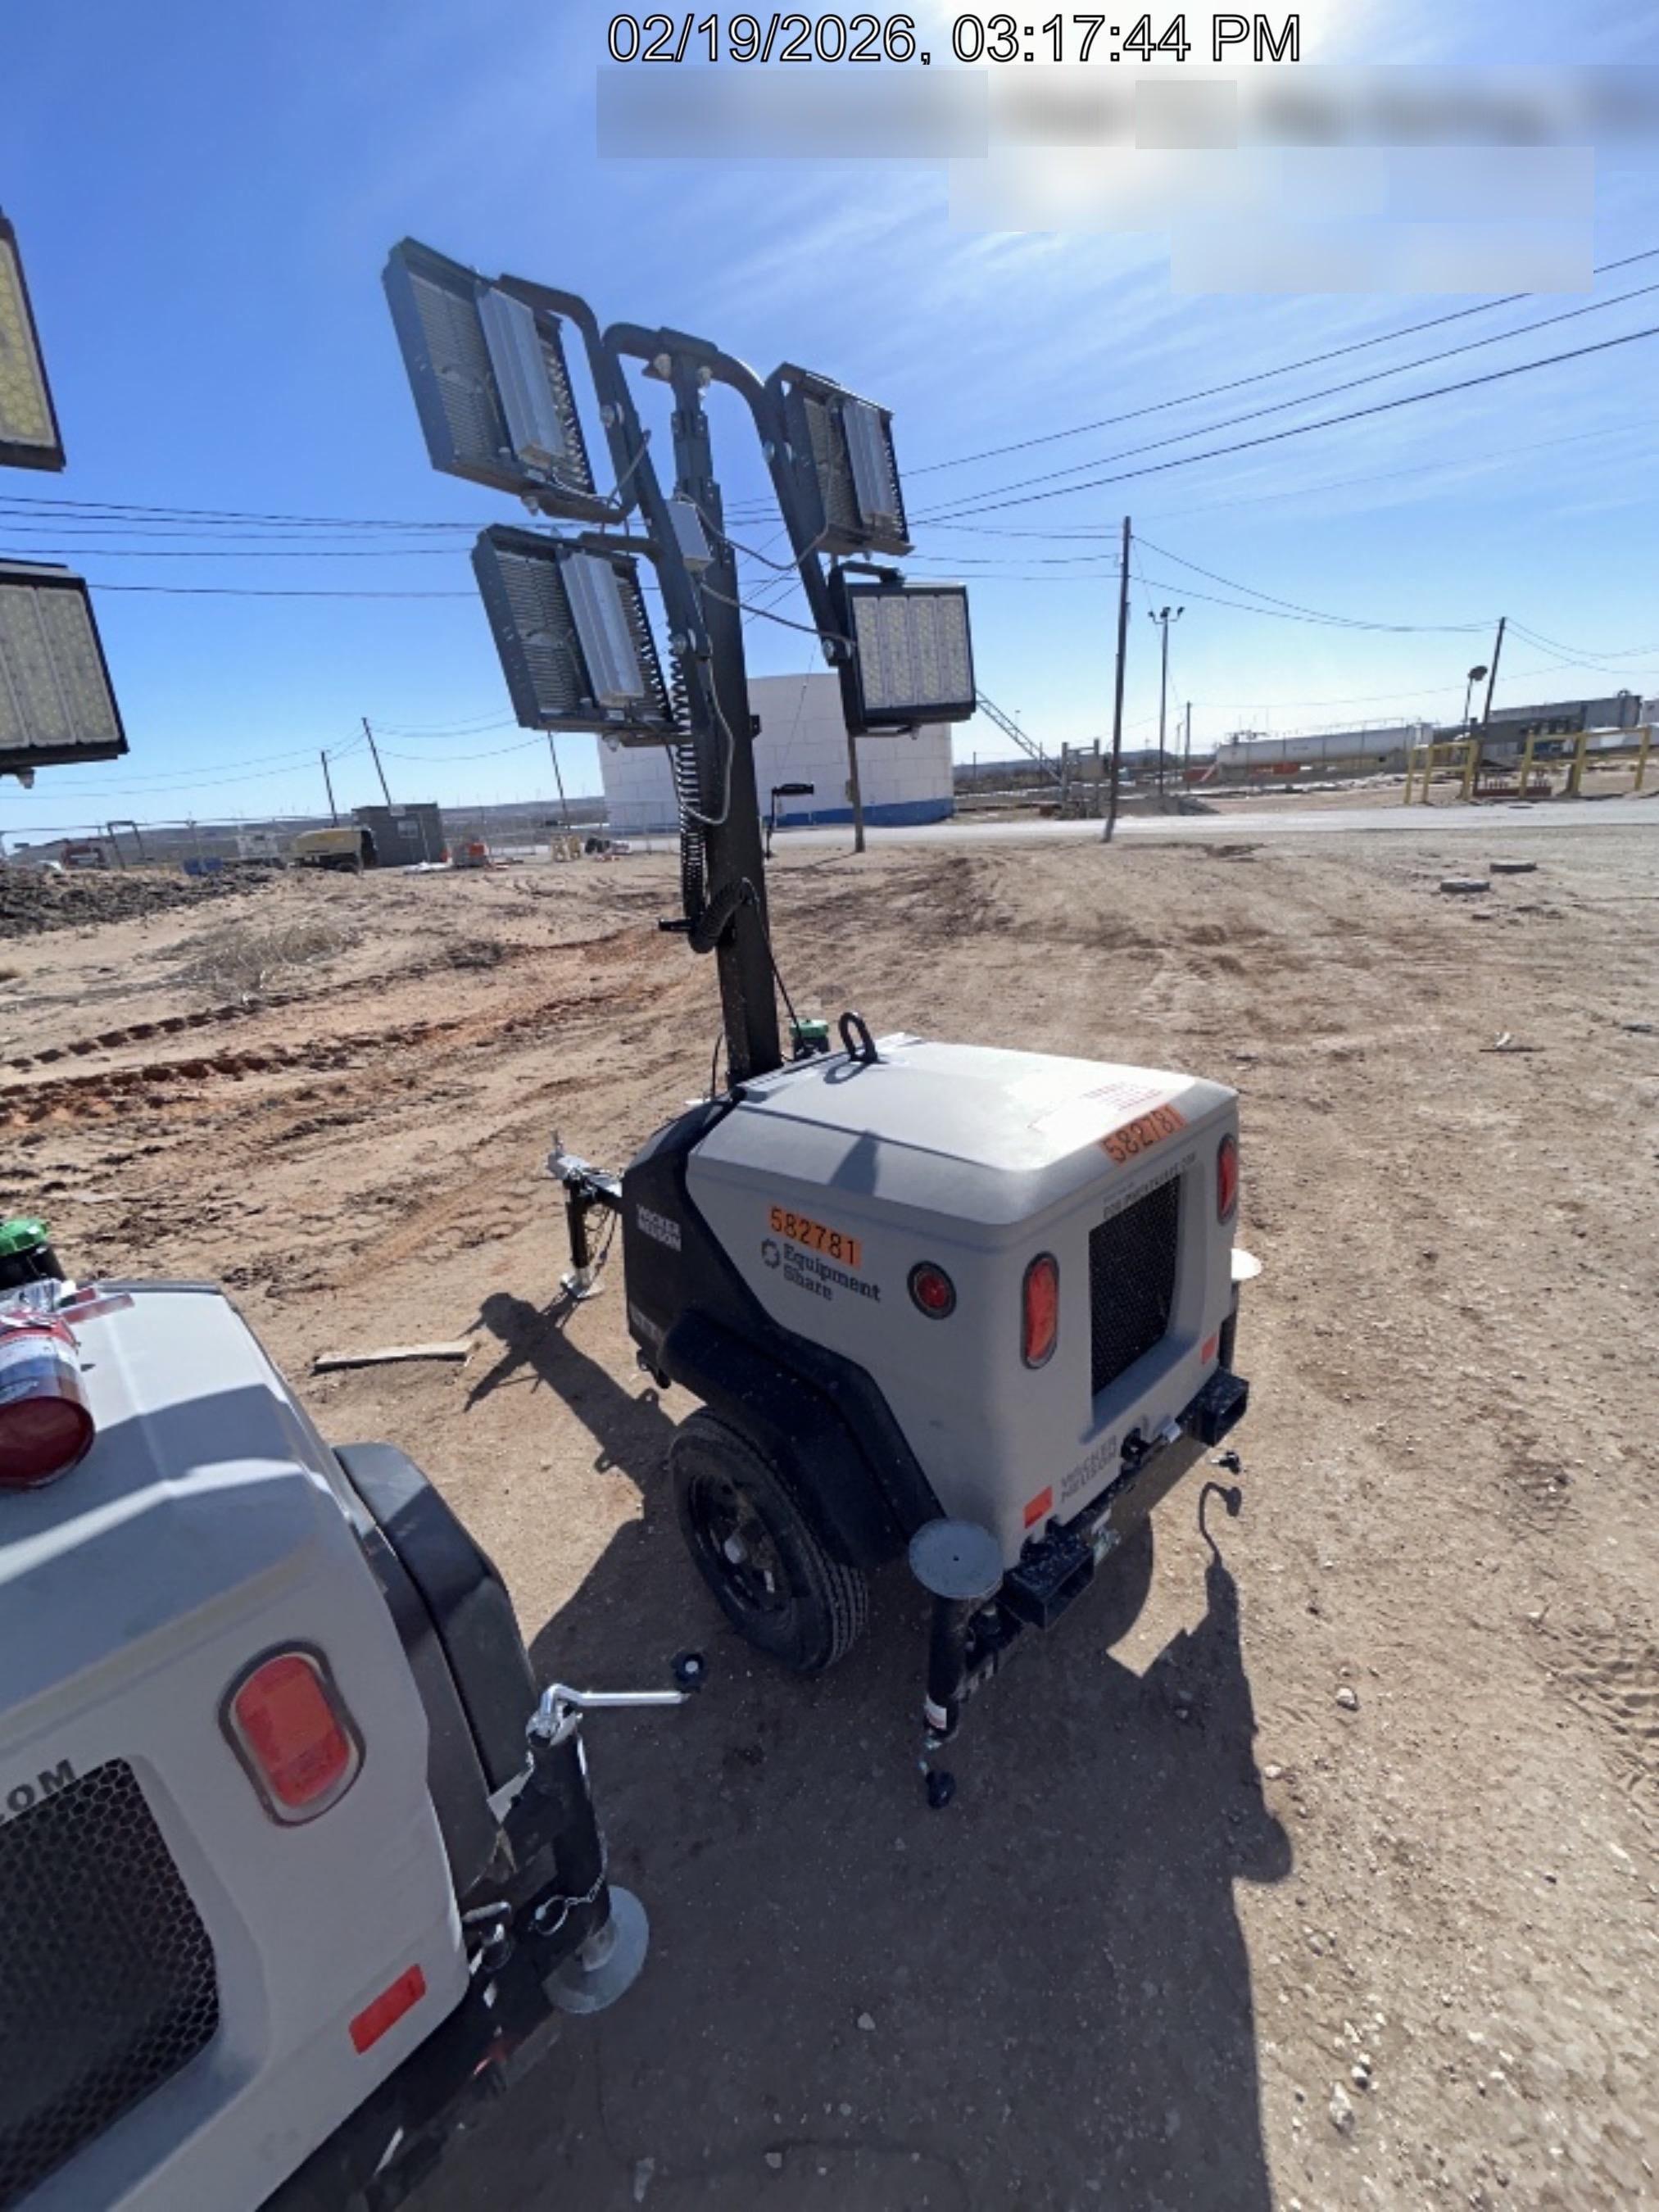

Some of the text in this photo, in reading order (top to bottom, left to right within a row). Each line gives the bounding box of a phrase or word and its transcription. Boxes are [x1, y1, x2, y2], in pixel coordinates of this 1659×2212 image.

[1103, 1104, 1184, 1164] 582781
[771, 1205, 854, 1266] 582781
[783, 1242, 882, 1303] Equipment
[783, 1264, 833, 1302] Share
[0, 1758, 76, 1822] OM
